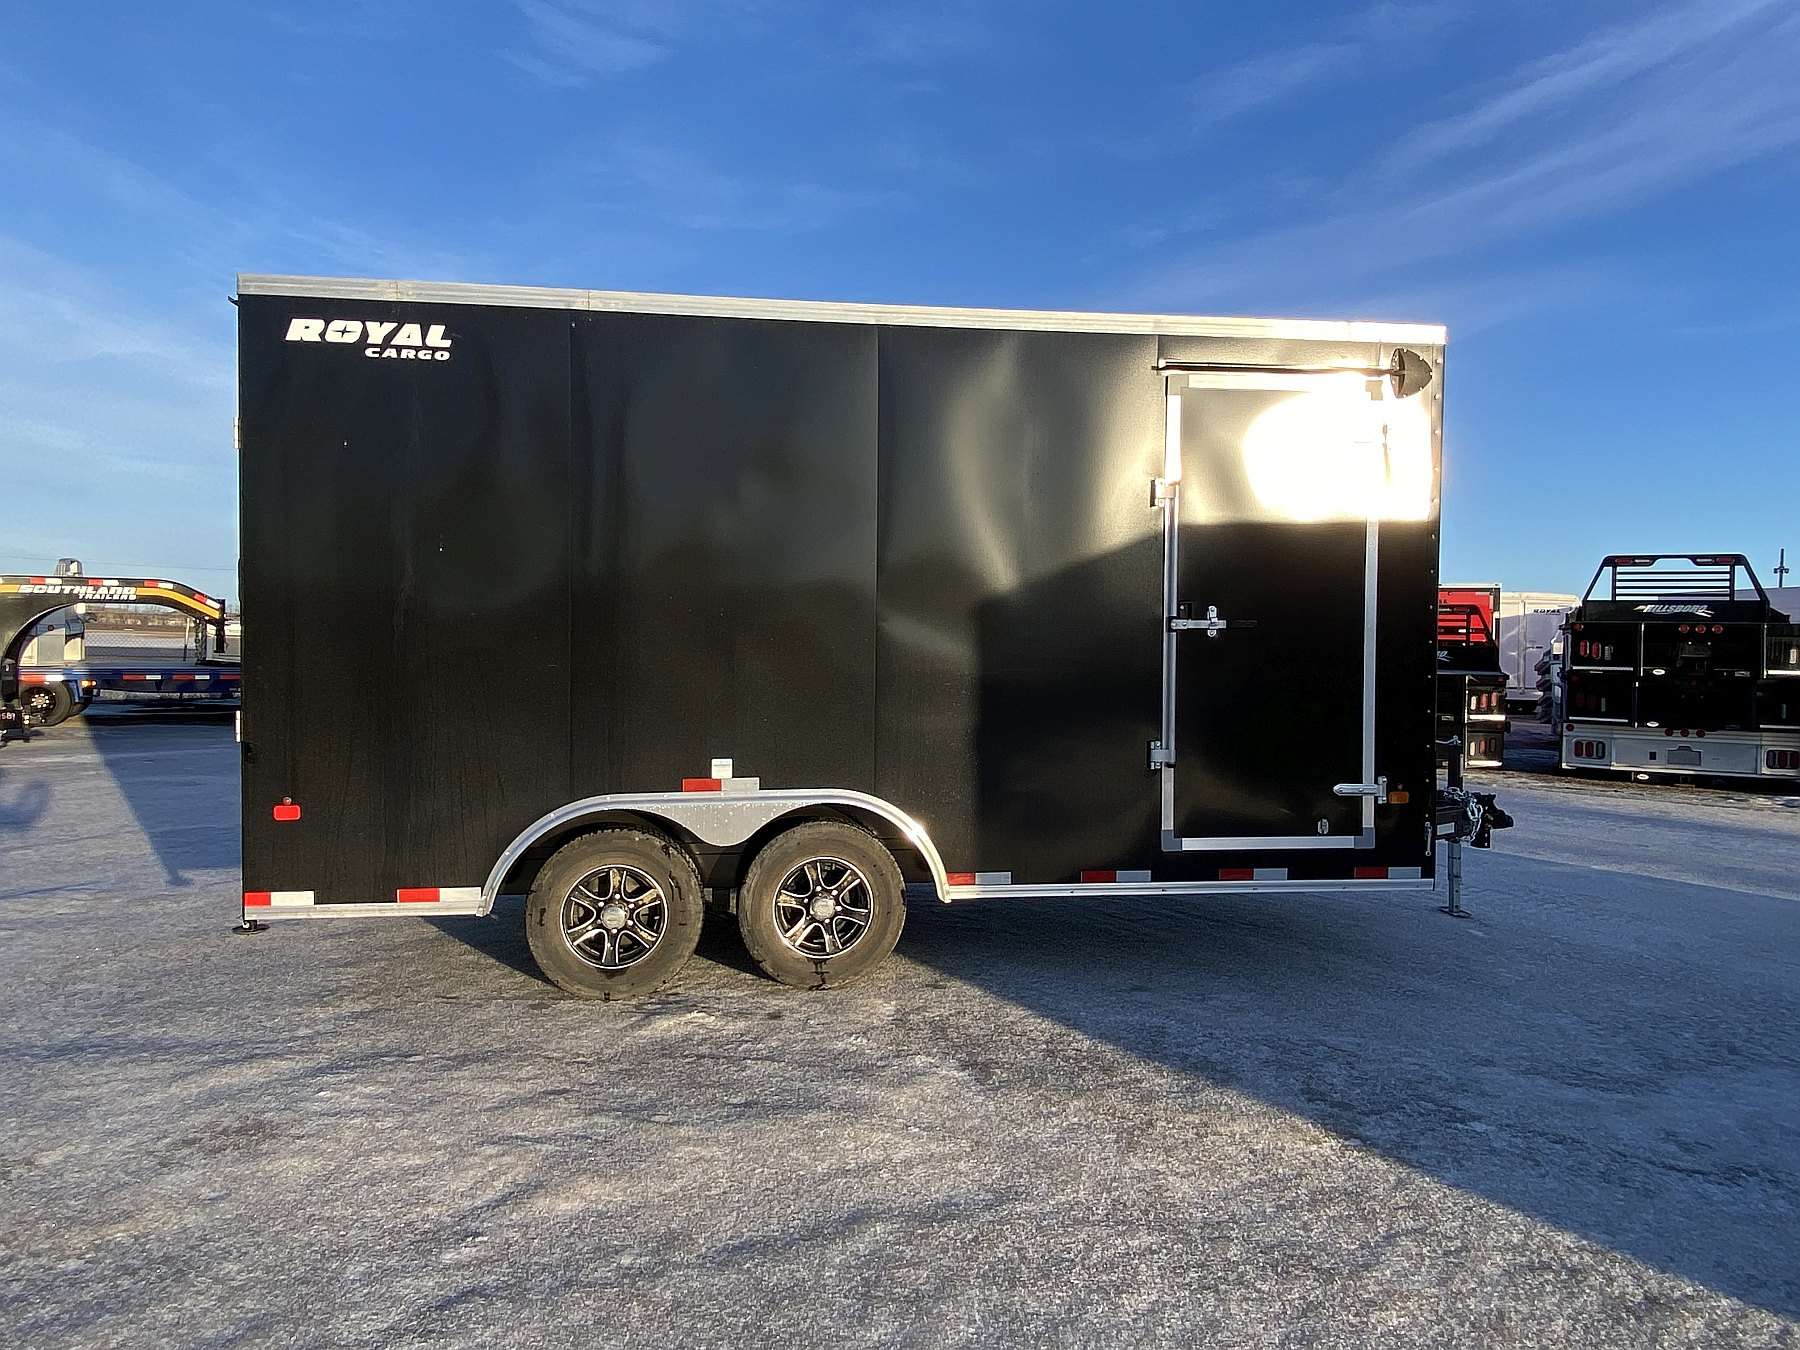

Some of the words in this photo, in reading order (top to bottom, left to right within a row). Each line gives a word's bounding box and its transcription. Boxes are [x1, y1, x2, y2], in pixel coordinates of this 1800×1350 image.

[285, 318, 452, 348] ROYAL
[364, 347, 451, 361] CARGO
[18, 584, 137, 595] SOUTHLAND
[78, 593, 137, 601] TRAILERS
